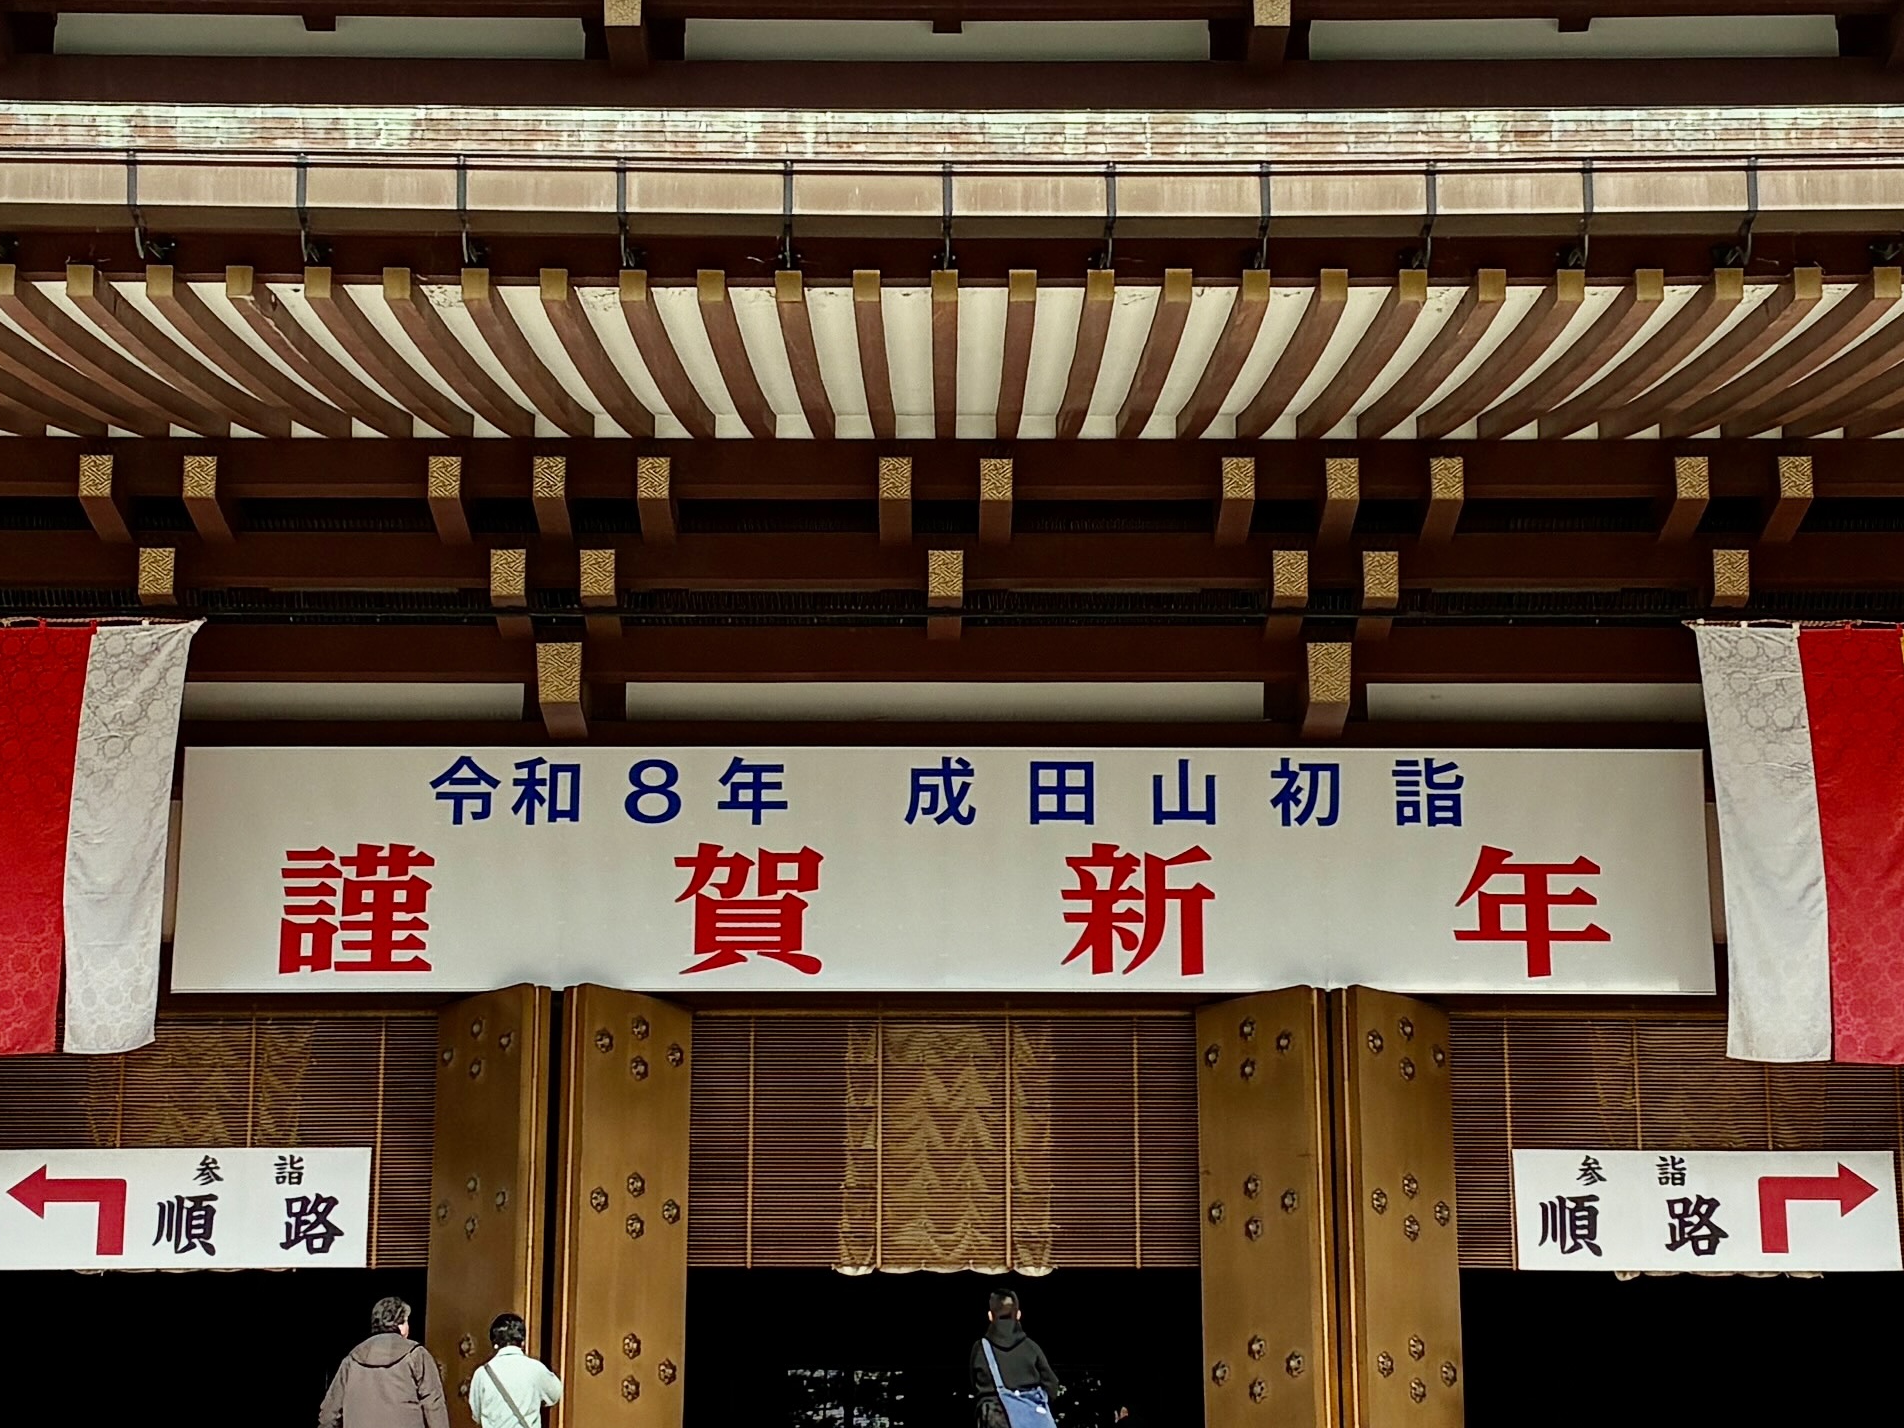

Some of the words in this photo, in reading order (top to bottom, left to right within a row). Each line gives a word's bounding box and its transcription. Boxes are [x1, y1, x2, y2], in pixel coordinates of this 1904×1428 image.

[192, 1154, 305, 1187] 参詣
[1576, 1155, 1687, 1187] 参詣
[151, 1192, 345, 1257] 順路
[1538, 1193, 1729, 1257] 順路
